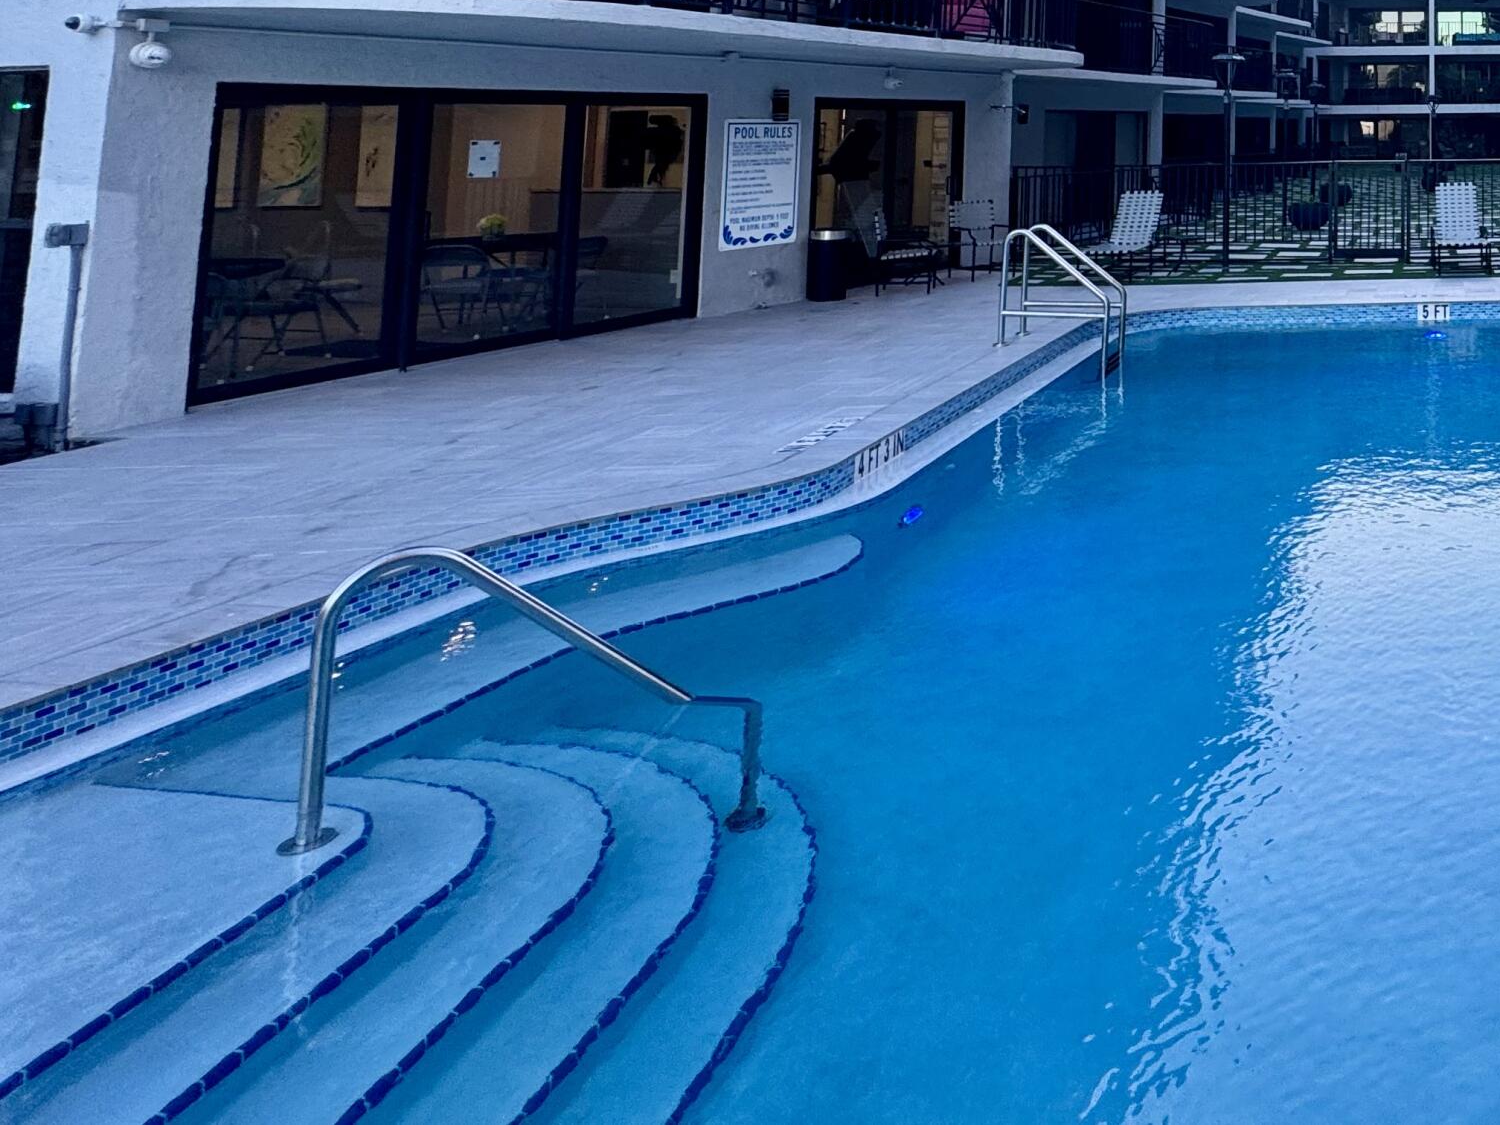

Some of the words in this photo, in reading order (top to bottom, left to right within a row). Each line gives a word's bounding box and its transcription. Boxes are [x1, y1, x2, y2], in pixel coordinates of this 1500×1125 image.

[734, 127, 760, 139] POOL
[764, 126, 793, 139] RULES
[1423, 305, 1429, 319] 5
[1434, 304, 1449, 319] FT
[858, 452, 864, 478] 4
[868, 442, 881, 473] FT
[884, 437, 889, 463] 3
[893, 429, 904, 457] IN
